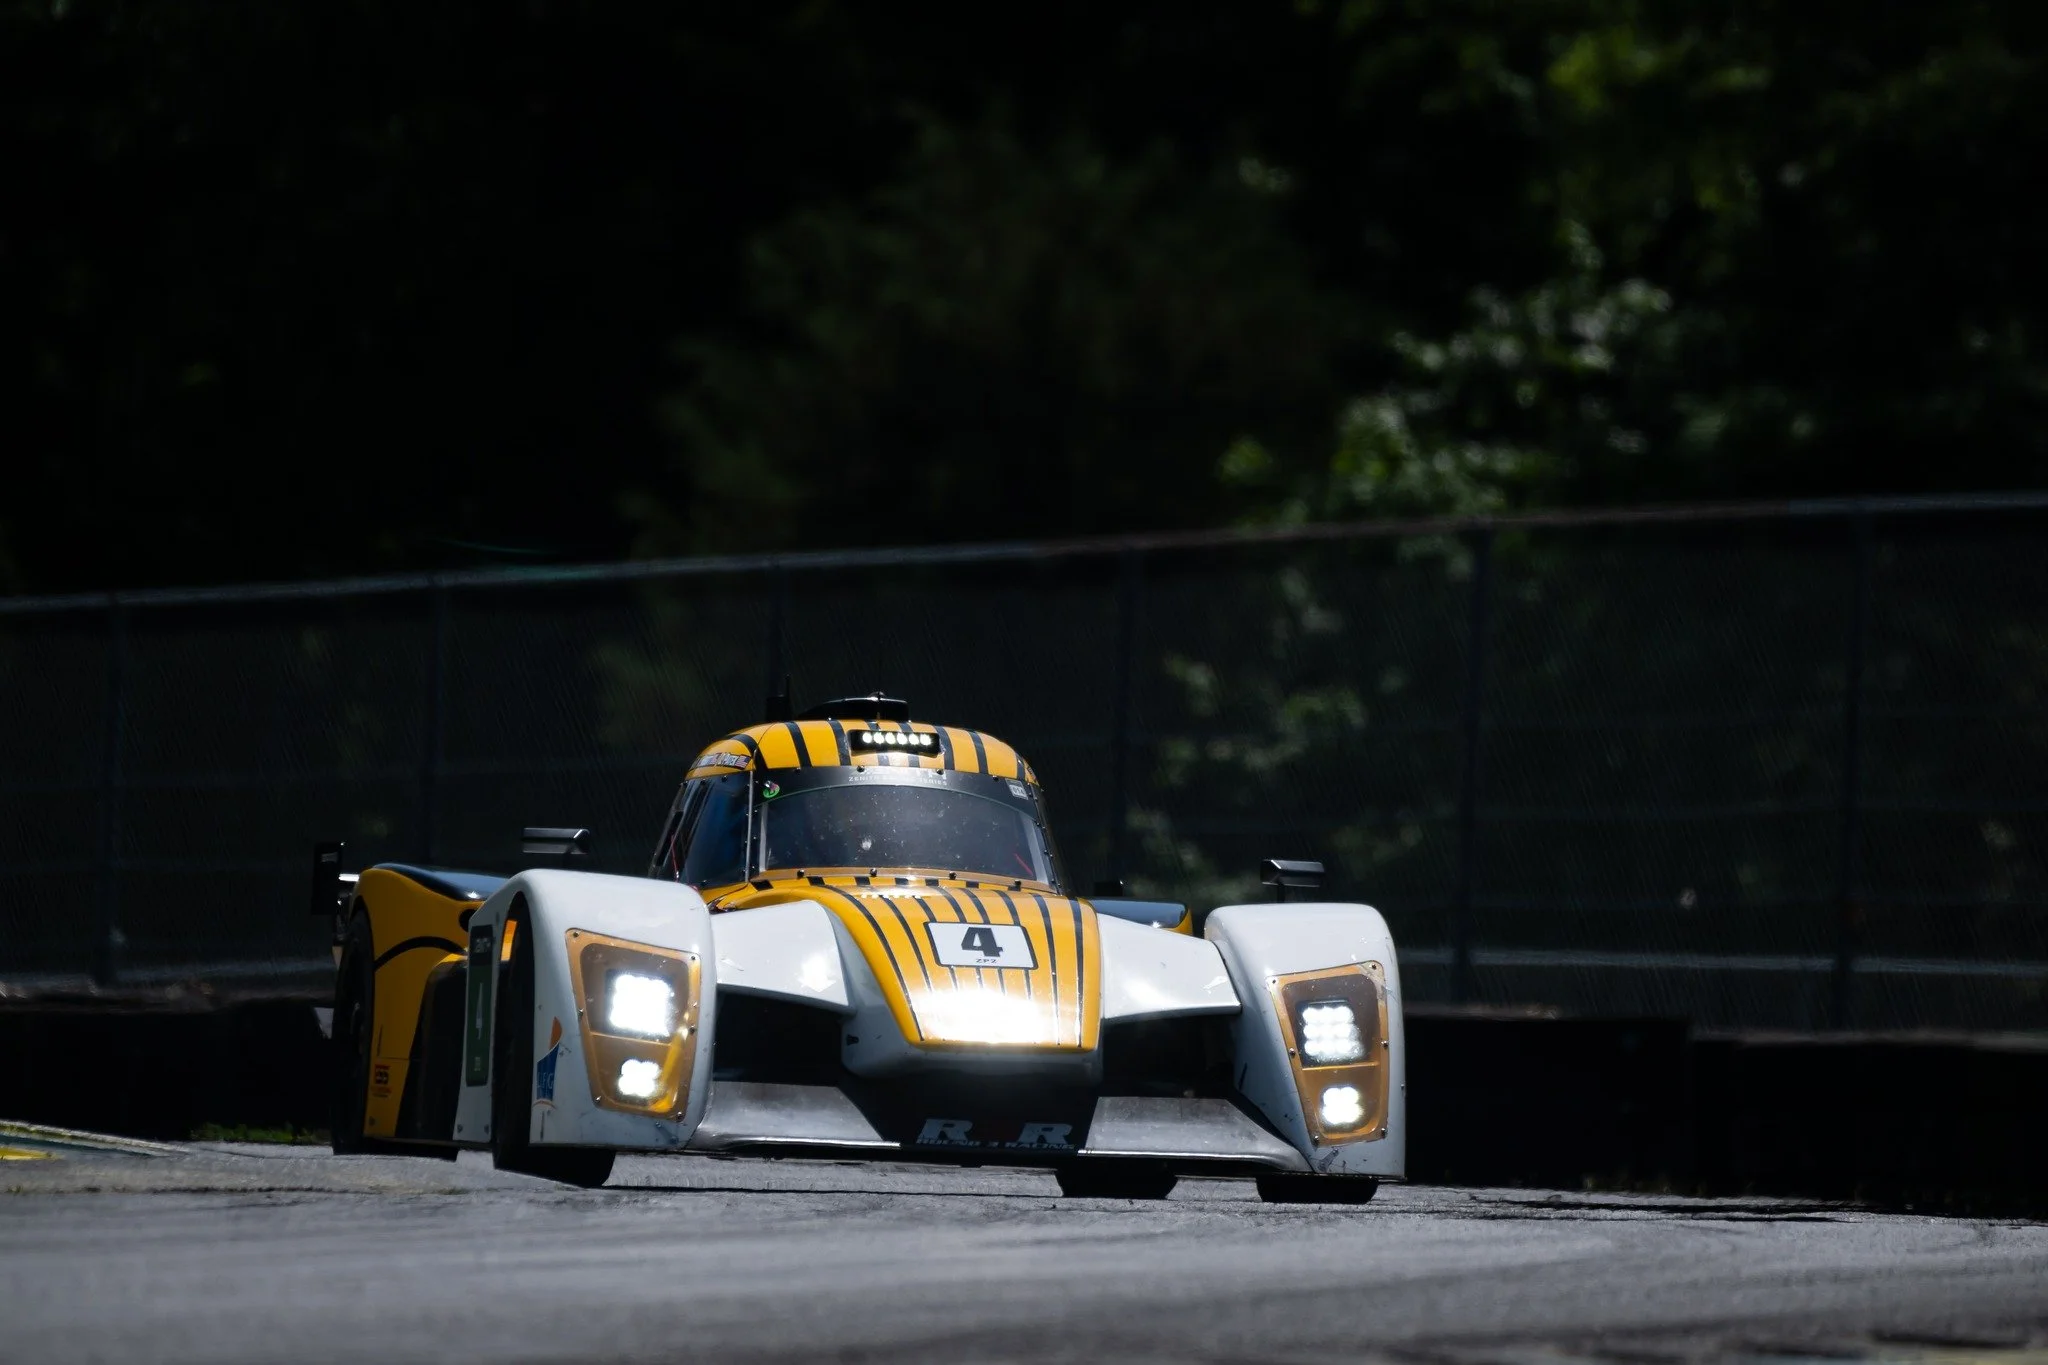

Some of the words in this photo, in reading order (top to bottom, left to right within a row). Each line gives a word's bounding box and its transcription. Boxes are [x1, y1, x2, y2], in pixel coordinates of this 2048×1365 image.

[961, 926, 1004, 957] 4
[918, 1118, 973, 1141] R
[1018, 1122, 1073, 1144] R
